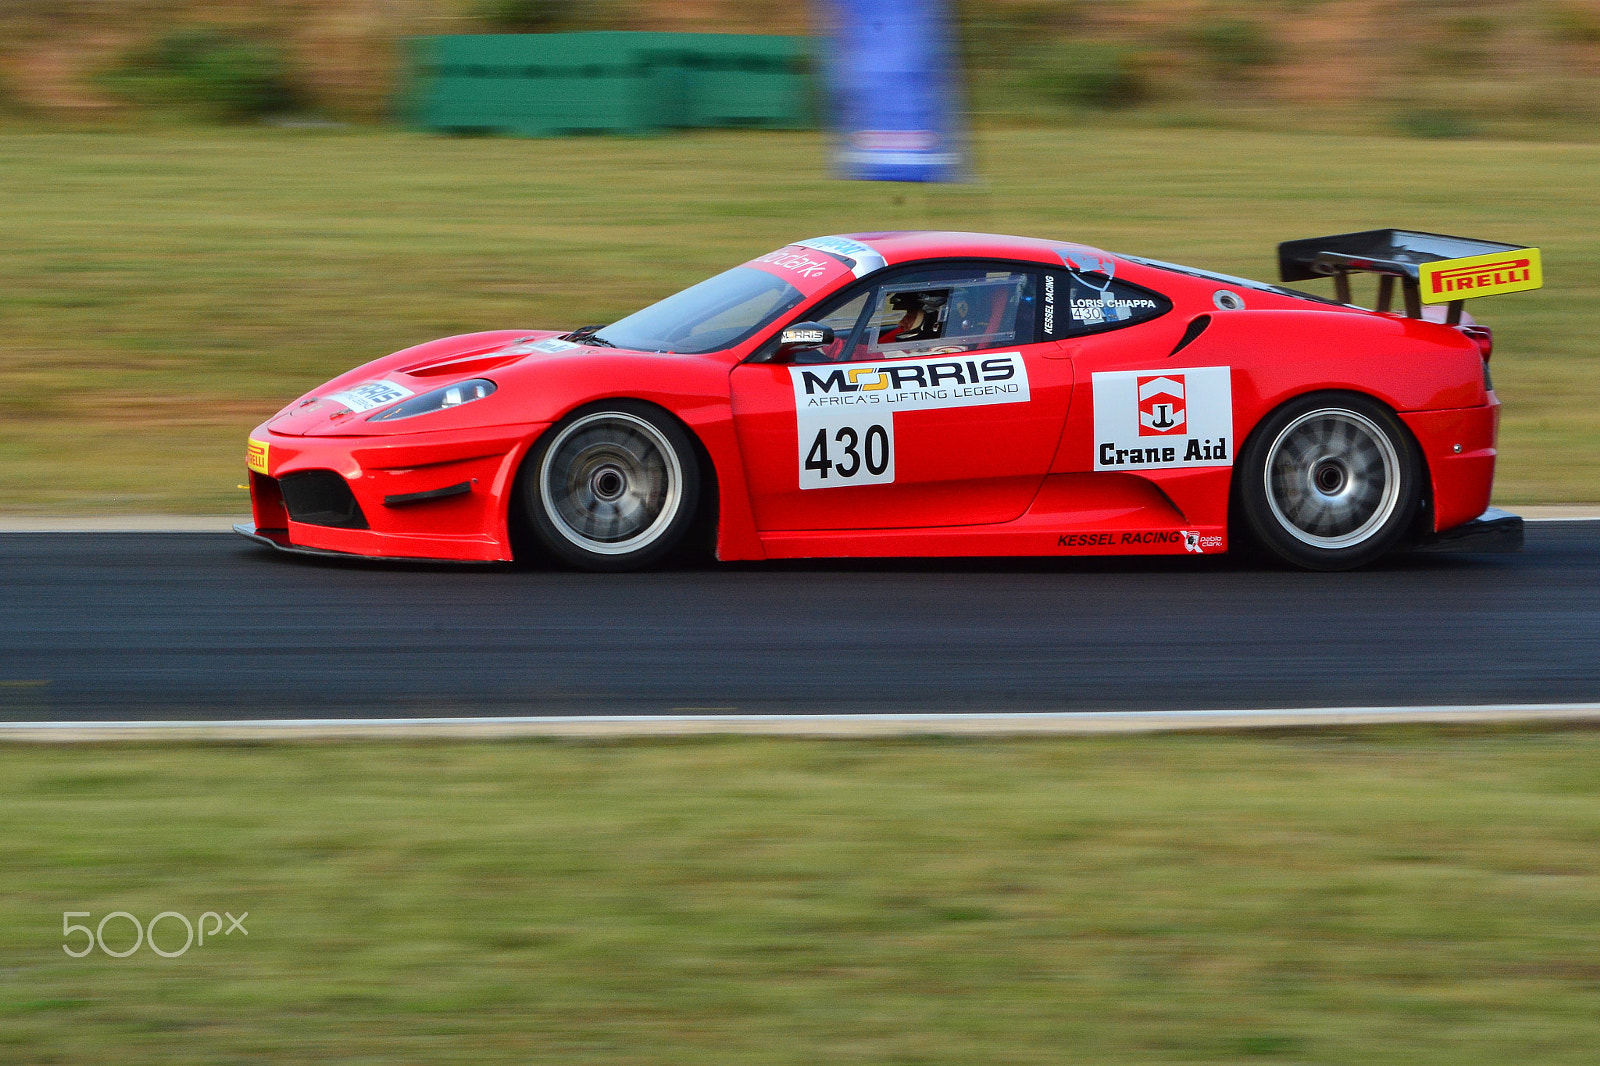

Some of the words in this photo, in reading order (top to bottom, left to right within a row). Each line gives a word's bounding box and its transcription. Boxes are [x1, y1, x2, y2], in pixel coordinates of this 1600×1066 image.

[1045, 275, 1054, 304] RACING
[1431, 259, 1530, 293] PIRELLI
[1070, 299, 1104, 308] LORIS
[1107, 300, 1156, 308] CHIAPPA
[1073, 308, 1101, 319] 430
[1044, 304, 1054, 334] KESSEL
[802, 358, 1015, 394] MORRIS
[808, 394, 880, 407] AFRICA'S
[886, 389, 948, 403] LIFTING
[954, 383, 1019, 398] LEGEND
[805, 424, 889, 479] 430
[1100, 442, 1175, 465] Crane
[1184, 438, 1227, 461] Aid
[1057, 534, 1116, 547] KESSEL
[1121, 531, 1180, 545] RACING
